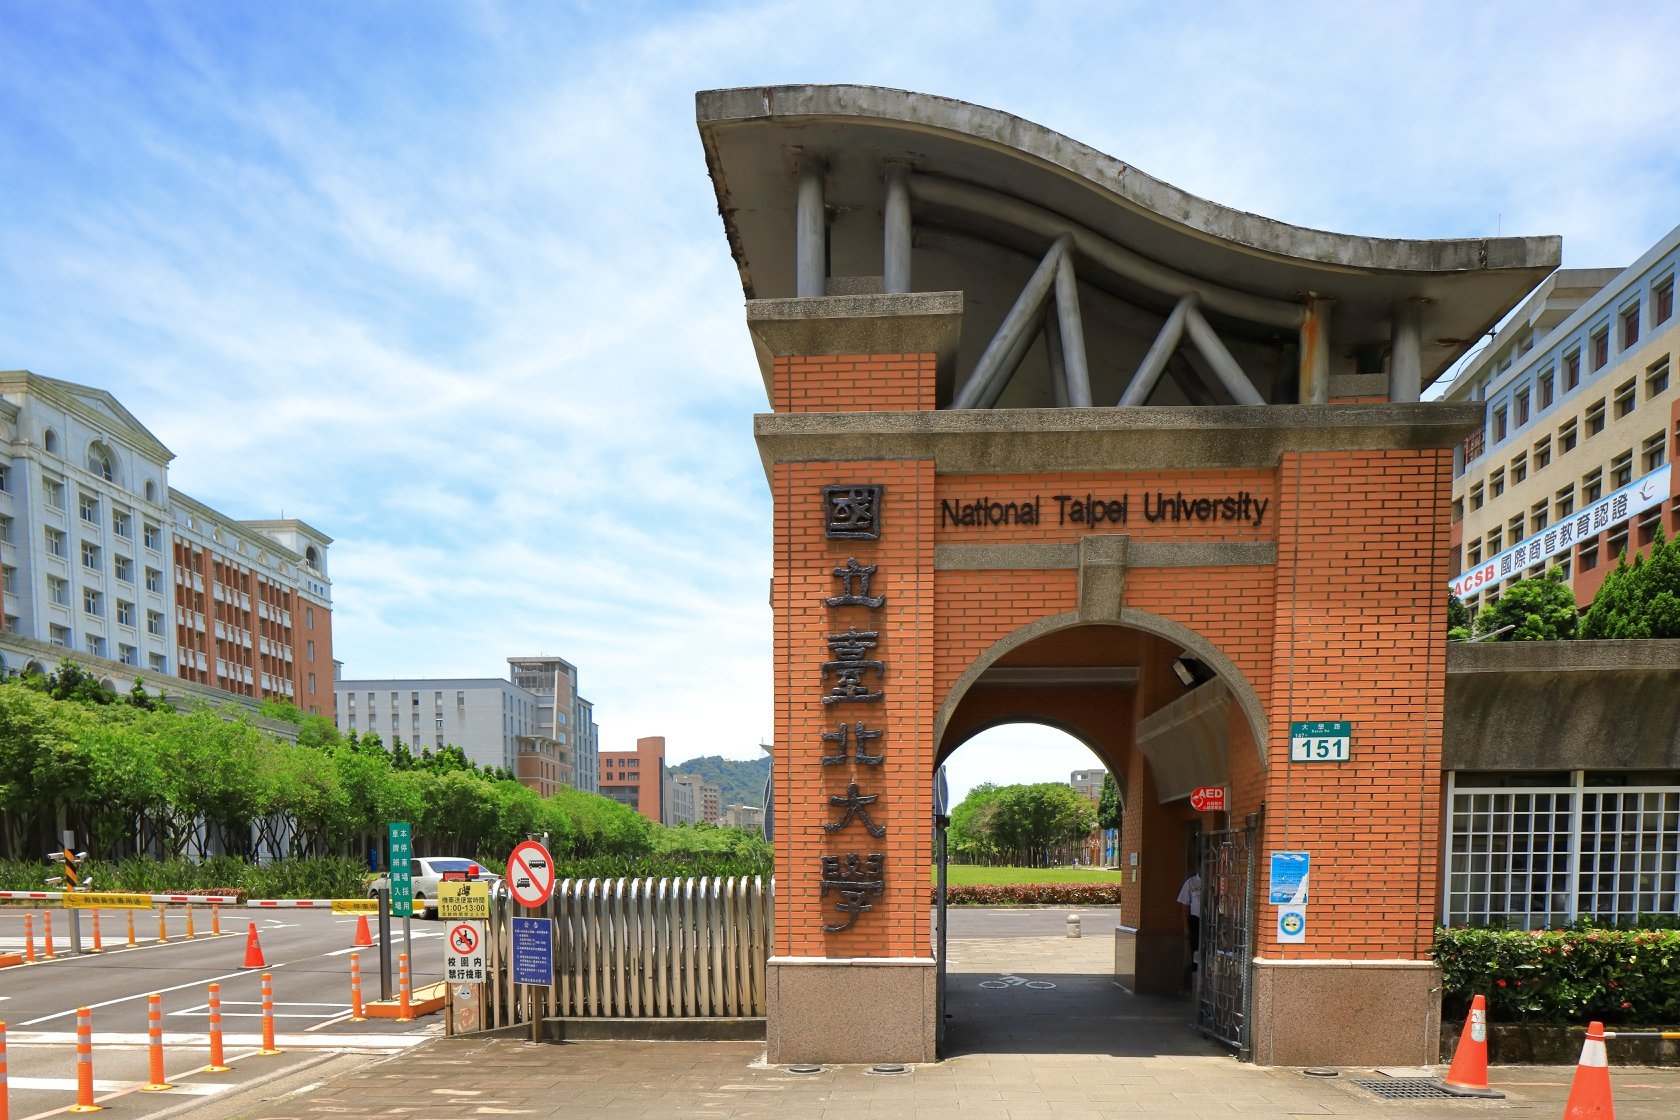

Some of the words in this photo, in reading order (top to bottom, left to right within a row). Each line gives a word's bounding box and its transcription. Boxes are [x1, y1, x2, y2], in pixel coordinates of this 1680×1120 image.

[941, 494, 1040, 527] National
[1053, 493, 1129, 529] Taipei
[1143, 490, 1269, 527] University
[1500, 492, 1628, 577] 國際商管教育認證
[821, 483, 886, 934] 國立臺北大學
[1302, 738, 1342, 758] 151
[1198, 788, 1223, 798] AED
[392, 829, 402, 911] 車牌辨識入場
[400, 829, 410, 911] 本停車場採用
[448, 957, 482, 967] 校園內
[448, 969, 483, 980] 禁行機車
